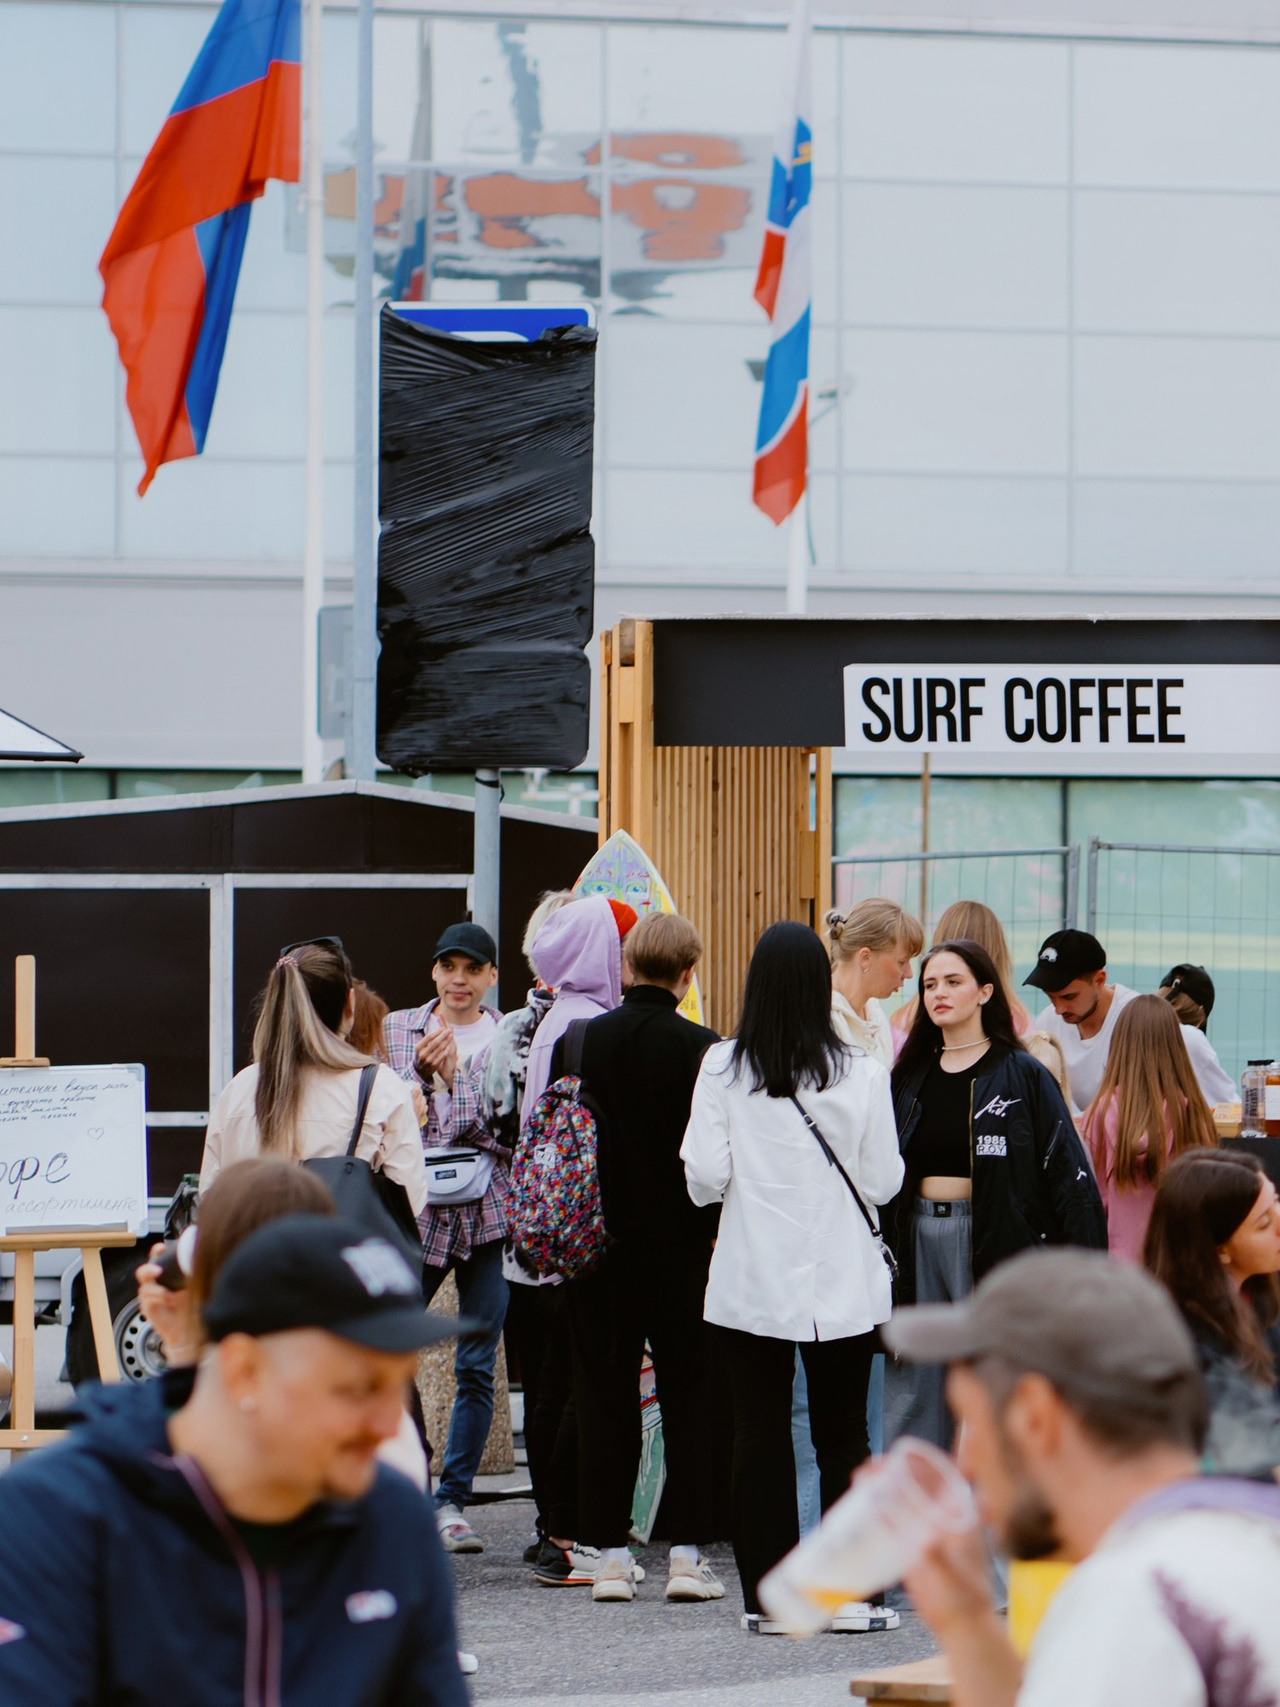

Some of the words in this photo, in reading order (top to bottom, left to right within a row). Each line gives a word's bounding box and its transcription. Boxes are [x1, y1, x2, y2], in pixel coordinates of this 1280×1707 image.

[861, 677, 986, 743] SURF
[1004, 677, 1186, 744] COFFEE
[977, 1135, 1006, 1146] 1985
